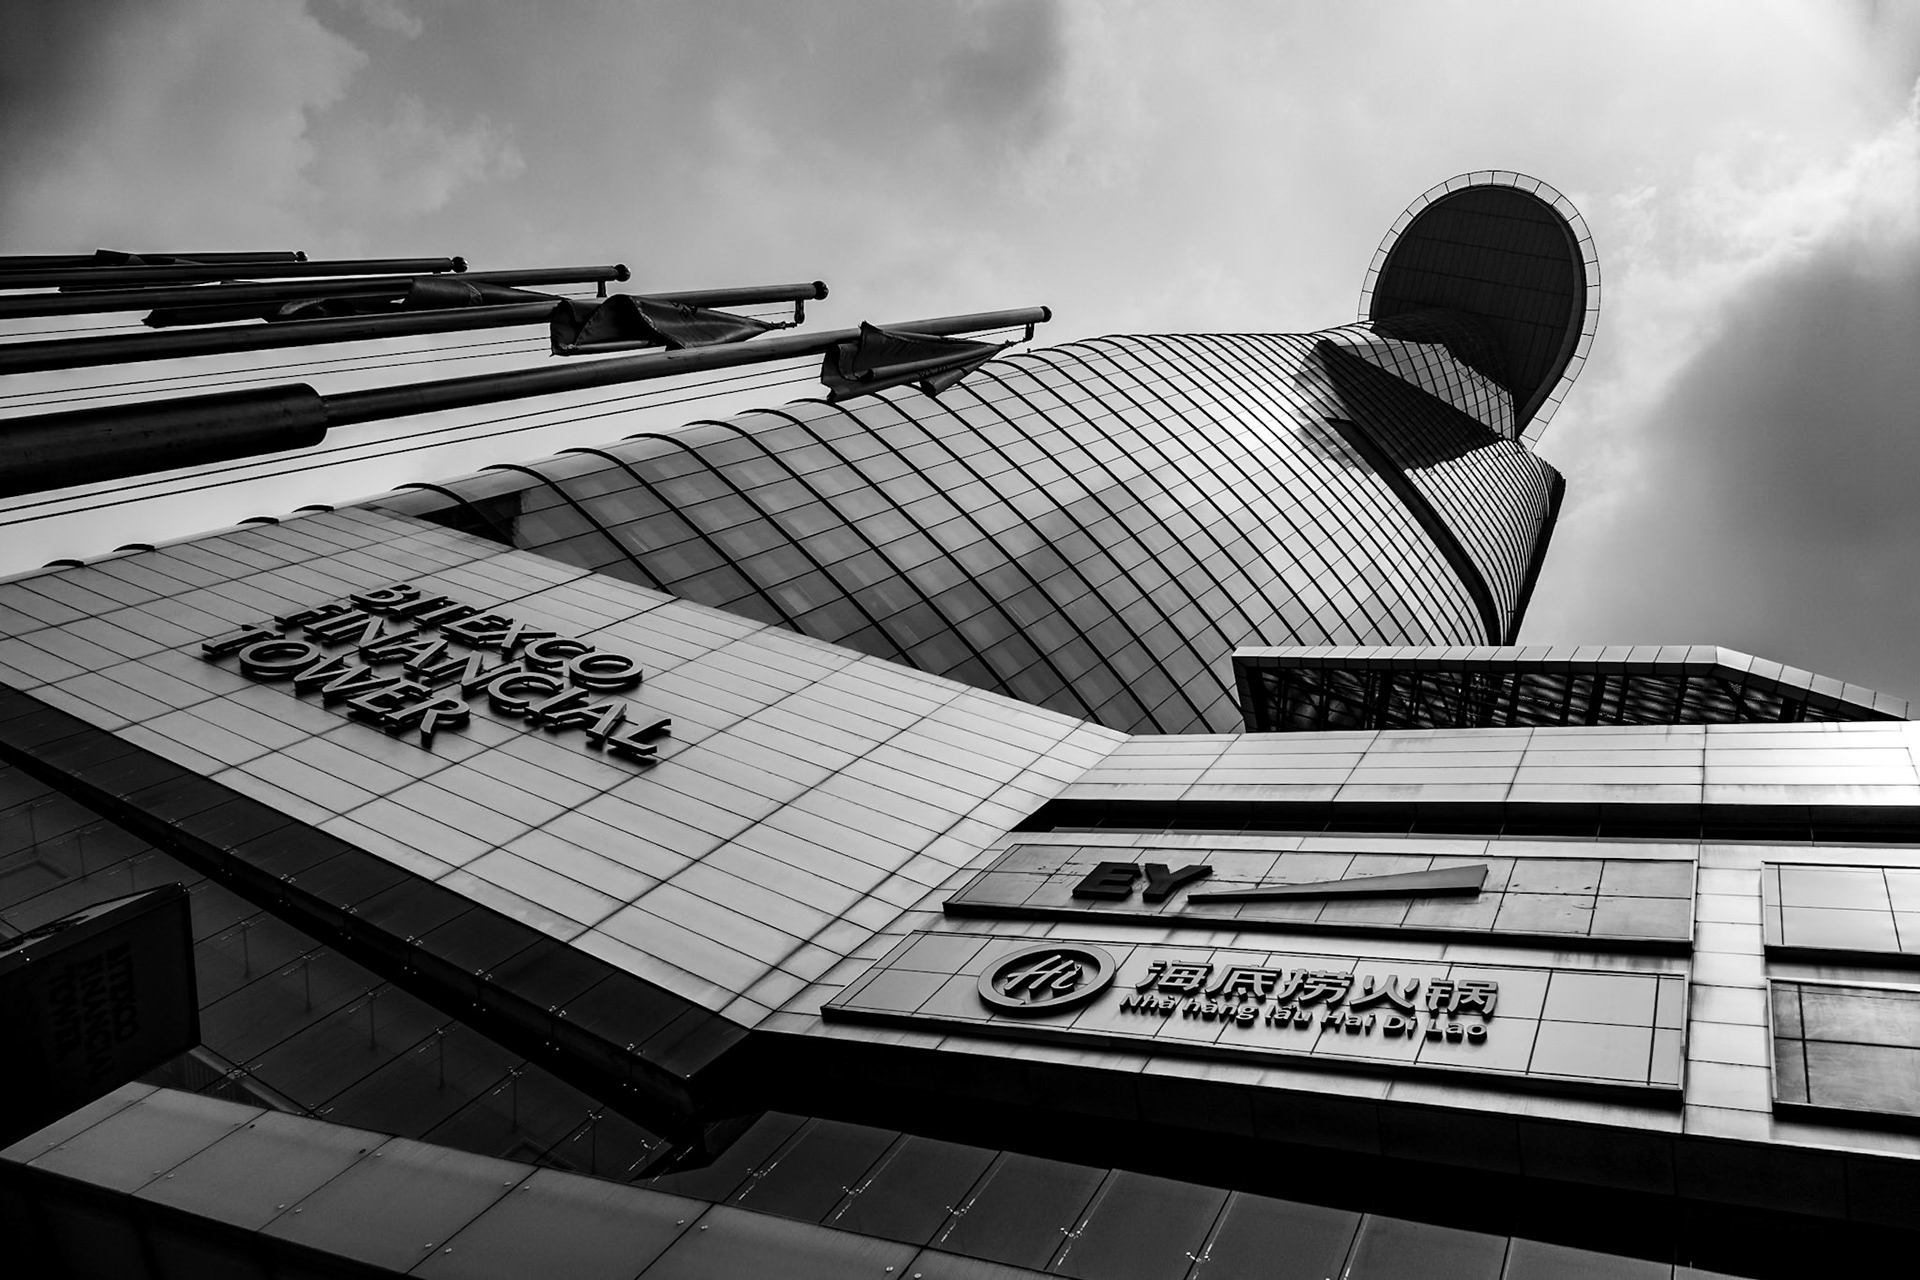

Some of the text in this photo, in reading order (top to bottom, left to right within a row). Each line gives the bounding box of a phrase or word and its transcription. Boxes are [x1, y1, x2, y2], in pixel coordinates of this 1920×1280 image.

[202, 623, 471, 747] TOWER
[274, 604, 671, 762] FINANCIAL
[350, 583, 643, 692] BITEXCO
[1072, 861, 1213, 903] EY
[46, 963, 82, 1063] TOWER
[78, 953, 116, 1086] FINANCIAL
[105, 940, 140, 1044] BITEXCO
[1120, 994, 1177, 1016] Nhà
[1182, 998, 1260, 1027] hàng
[1321, 1010, 1376, 1035] Hai
[1383, 1014, 1418, 1039] Di
[1426, 1018, 1487, 1043] Lao
[1136, 960, 1498, 1021] 海底捞火锅
